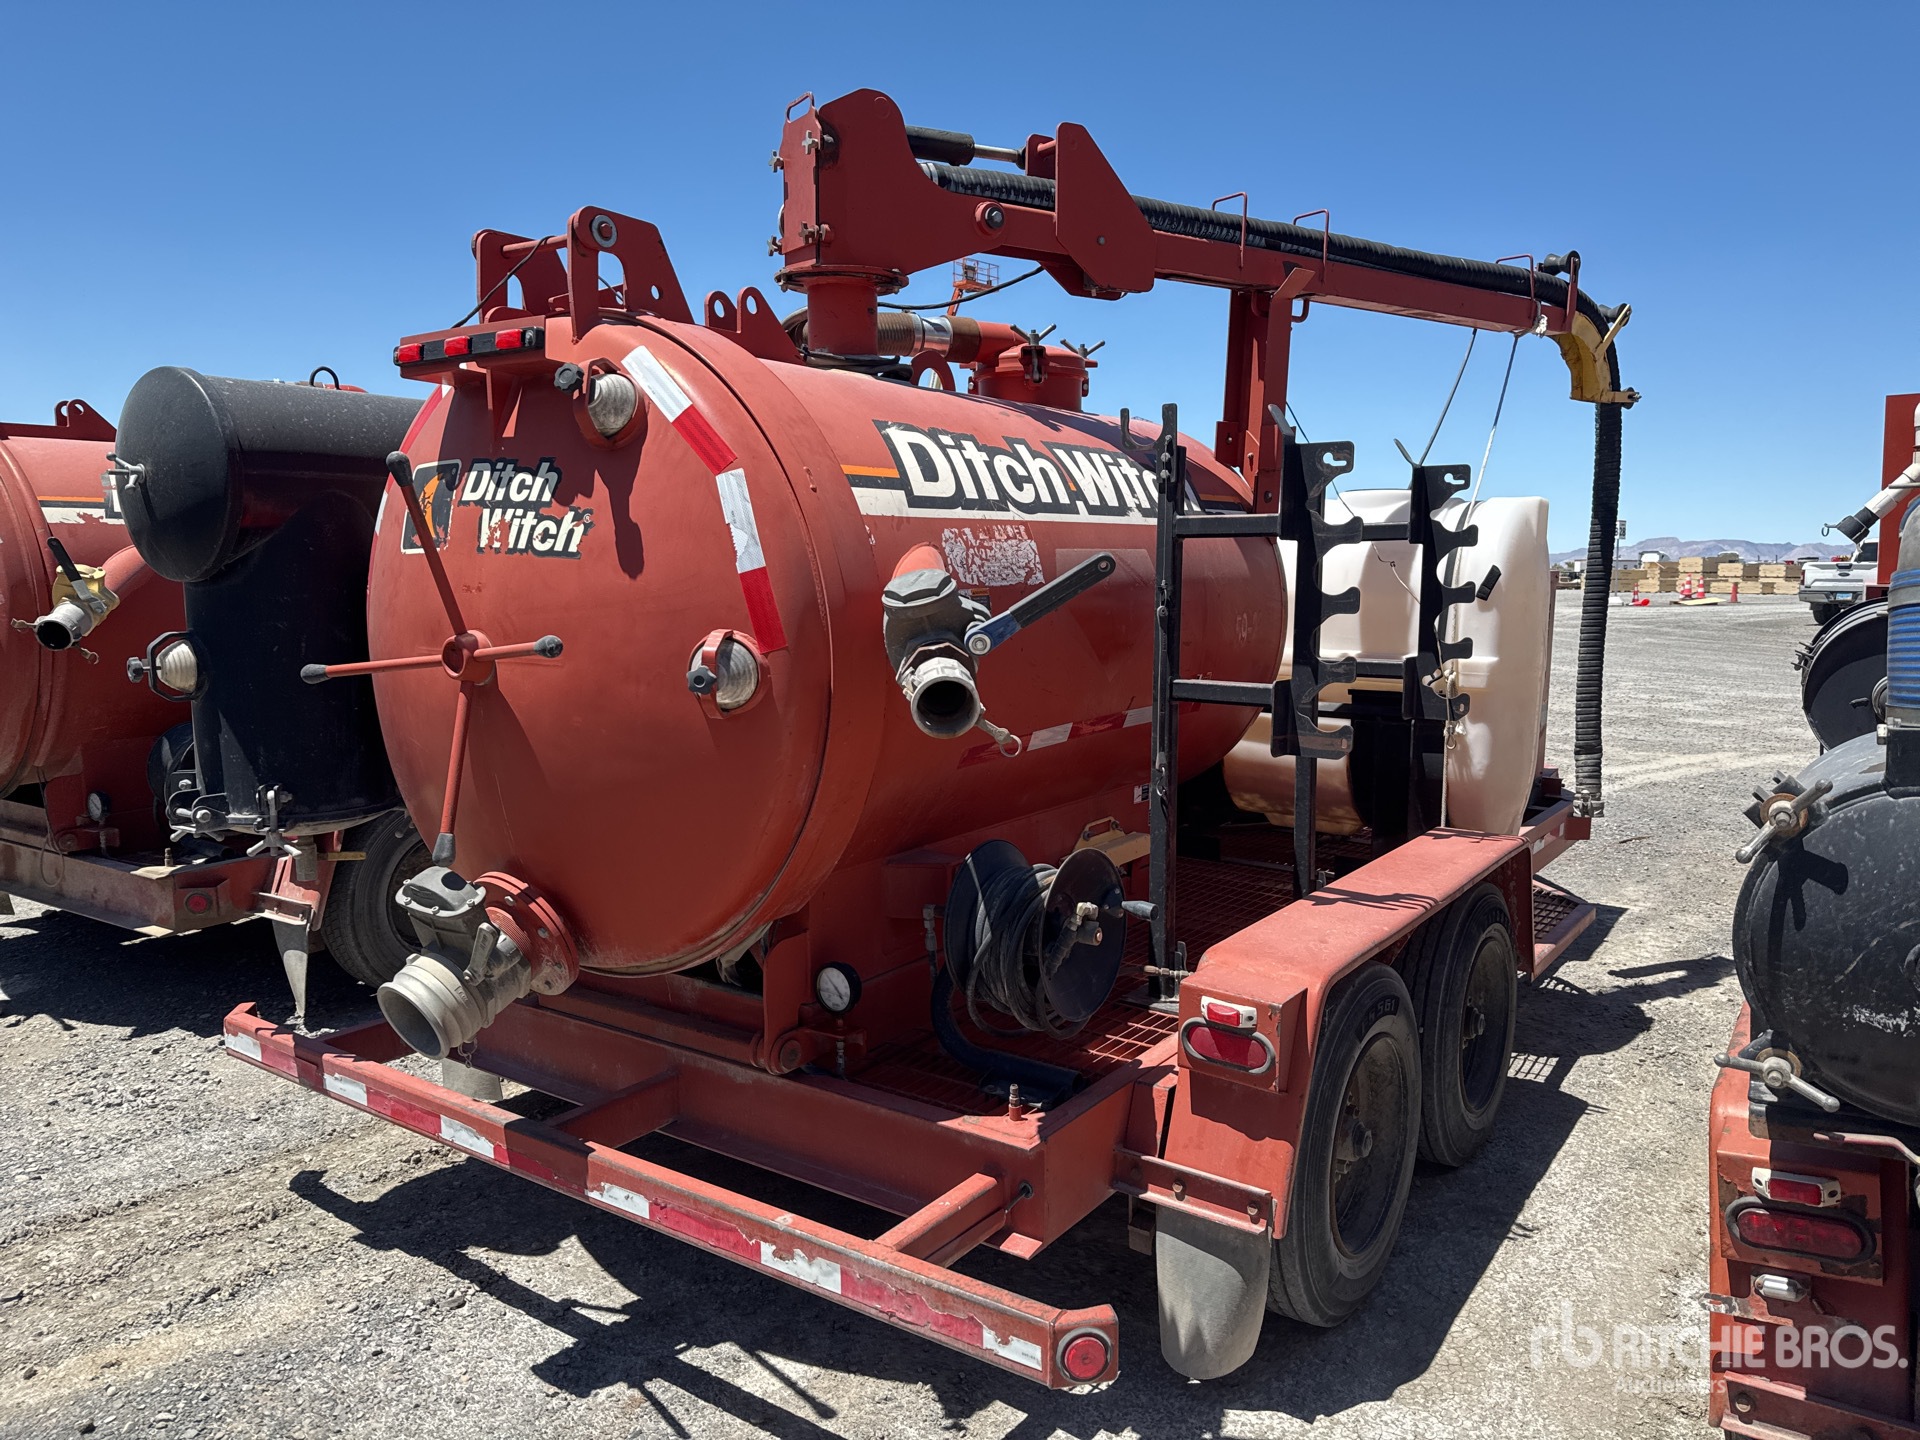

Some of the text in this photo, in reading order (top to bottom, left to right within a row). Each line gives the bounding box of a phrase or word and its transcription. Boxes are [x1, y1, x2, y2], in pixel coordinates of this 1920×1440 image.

[461, 462, 558, 502] Ditch
[888, 424, 1061, 505] Ditch
[479, 508, 585, 553] Witch
